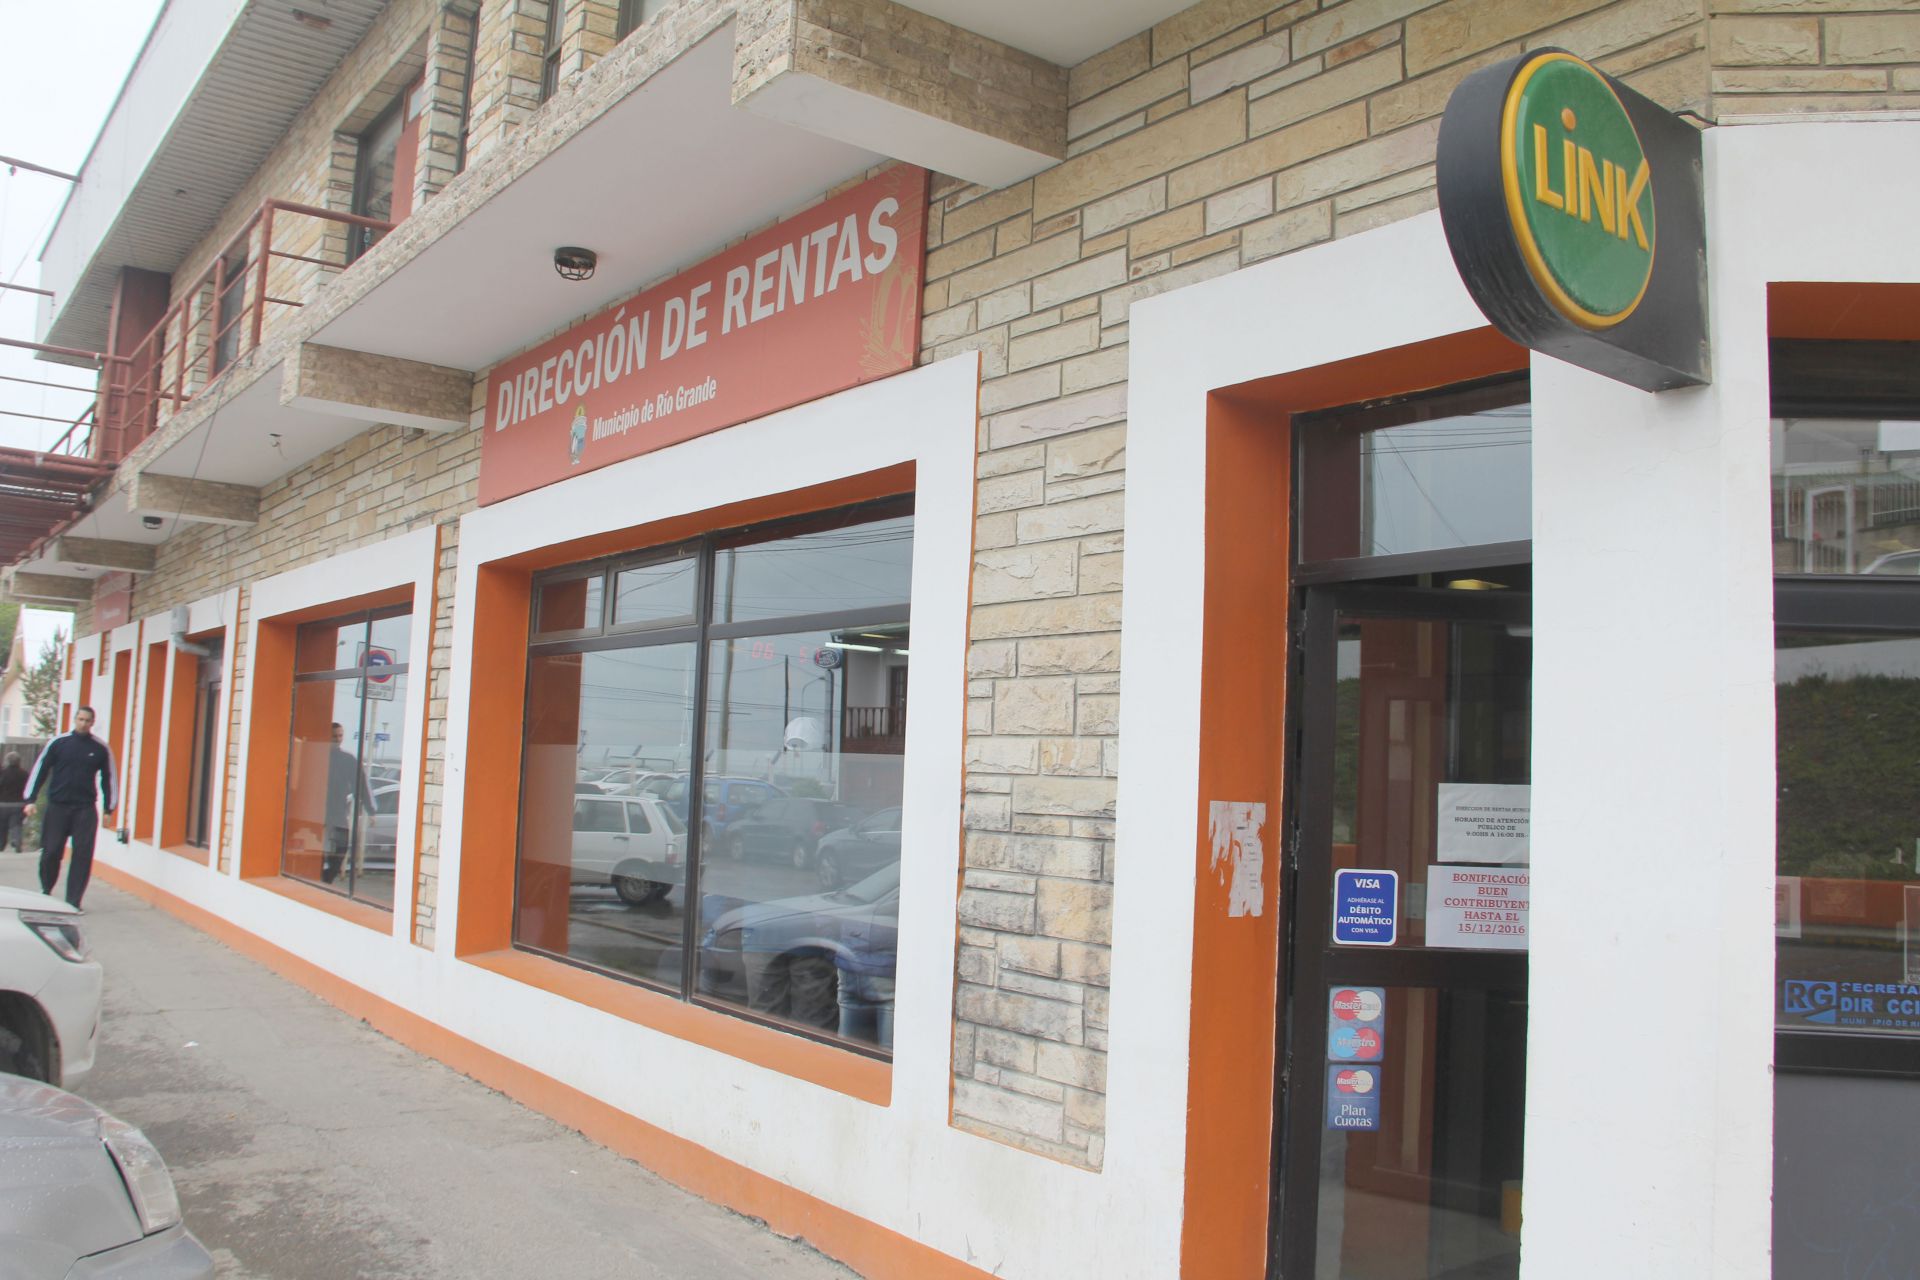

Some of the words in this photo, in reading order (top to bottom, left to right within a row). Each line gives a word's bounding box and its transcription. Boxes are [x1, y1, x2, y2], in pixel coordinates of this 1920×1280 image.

[495, 305, 650, 432] DIRECCIÓN
[659, 281, 711, 361] DE
[722, 197, 900, 336] RENTAS
[592, 404, 640, 442] Municipio
[640, 398, 654, 422] de
[655, 391, 674, 415] Río
[676, 375, 717, 411] Grande
[1354, 878, 1380, 889] VISA
[1452, 873, 1529, 885] BONIFICACIÓ
[1478, 886, 1508, 896] BUEN
[1349, 905, 1381, 915] DÉBITO
[1464, 910, 1502, 921] HASTA
[1505, 912, 1520, 921] EL
[1338, 915, 1392, 926] AUTOMÁTICO
[1458, 923, 1525, 934] 15/12/2016
[1841, 982, 1920, 995] SECRETA
[1341, 1104, 1366, 1116] Plan
[1334, 1115, 1372, 1127] Cuotas
